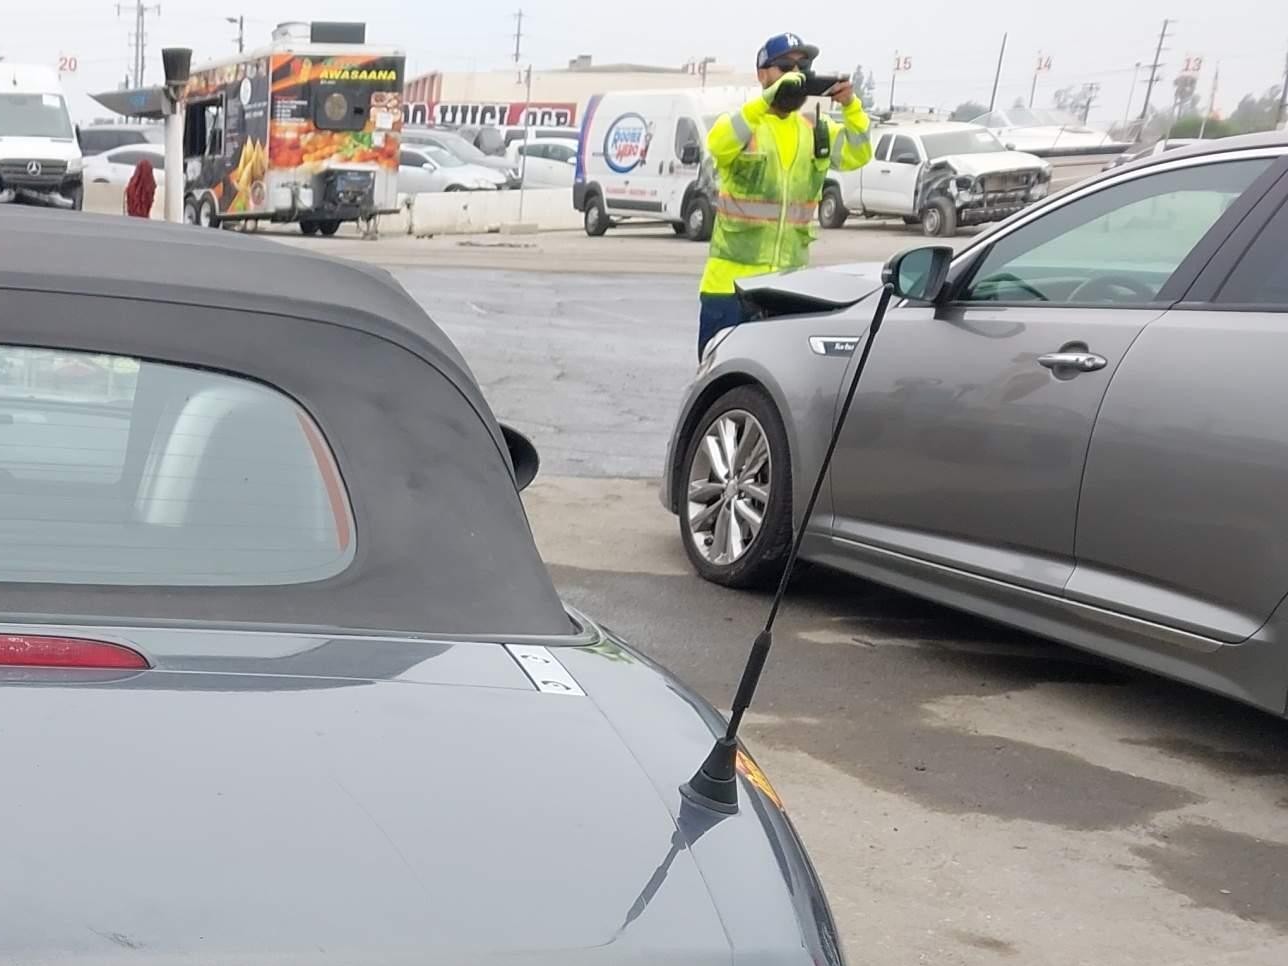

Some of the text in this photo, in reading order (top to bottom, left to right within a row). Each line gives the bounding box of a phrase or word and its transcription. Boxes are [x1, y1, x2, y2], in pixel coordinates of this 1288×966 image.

[59, 56, 78, 72] 20
[893, 56, 913, 71] 15
[1036, 56, 1053, 71] 14
[1182, 57, 1202, 72] 13
